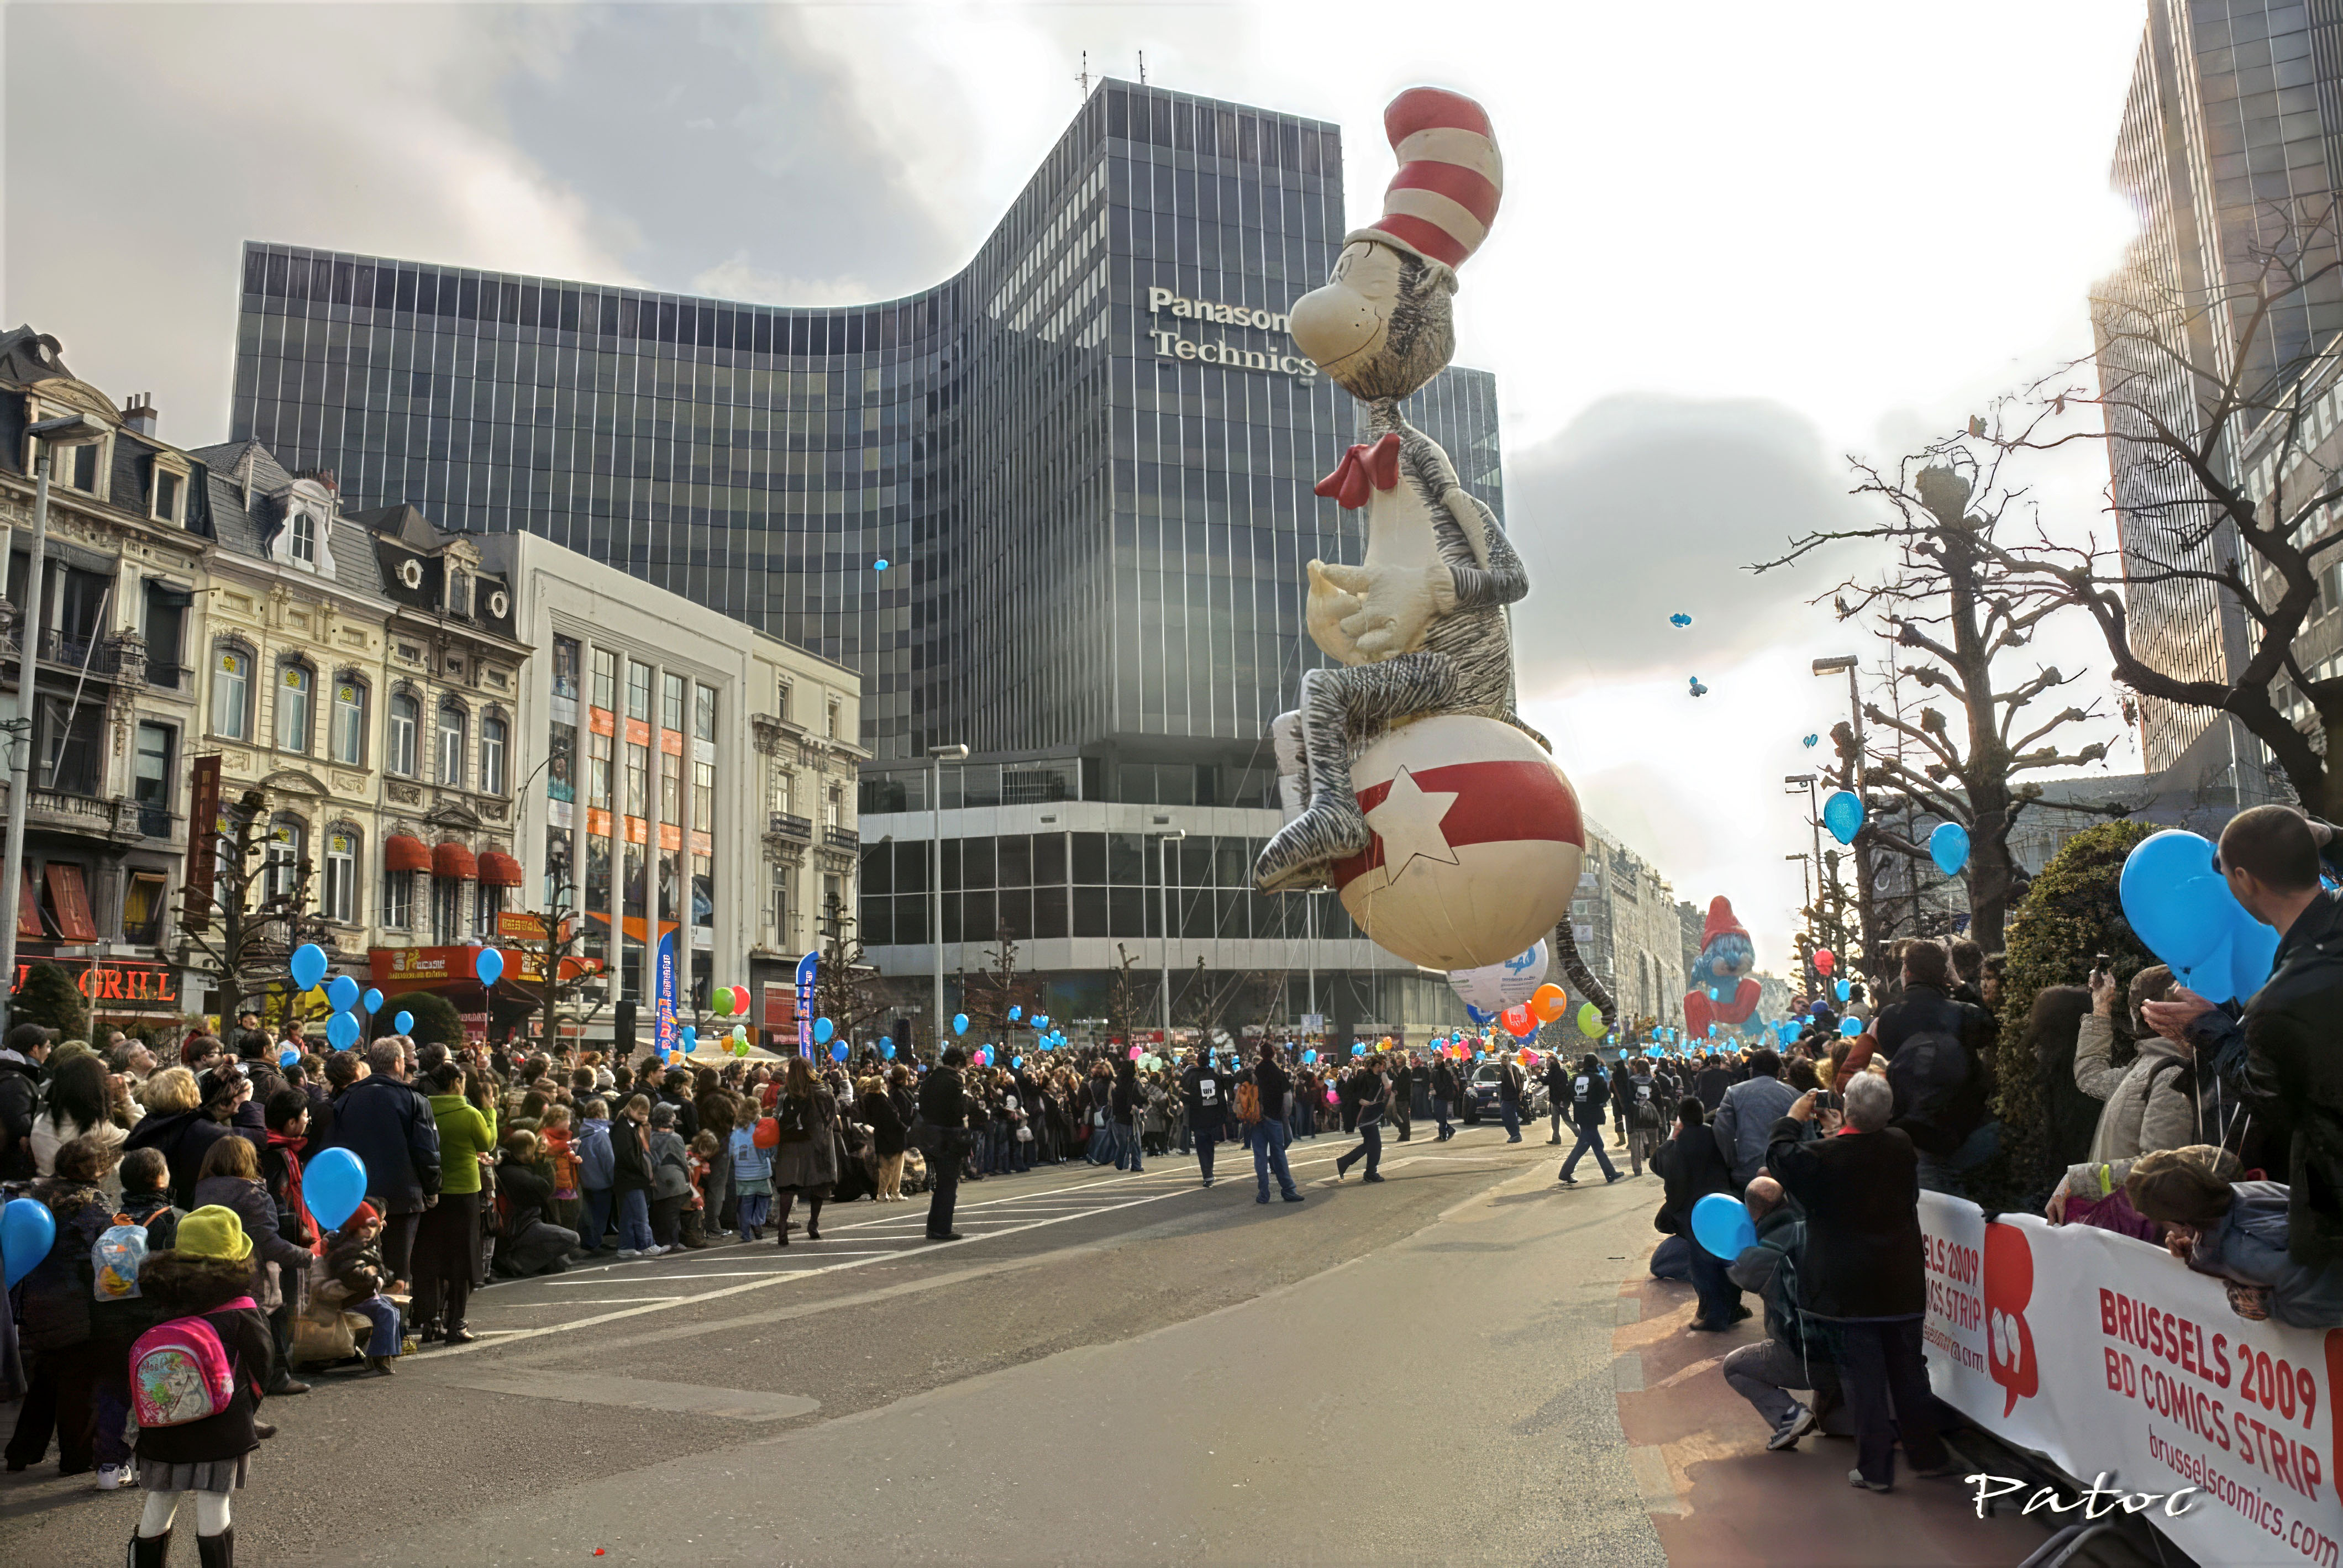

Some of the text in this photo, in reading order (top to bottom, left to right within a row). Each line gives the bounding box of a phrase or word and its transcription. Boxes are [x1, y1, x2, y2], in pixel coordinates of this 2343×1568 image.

[1149, 287, 1291, 333] Panason
[1149, 327, 1318, 377] Technics
[78, 969, 176, 1002] GRILL
[1945, 1287, 1981, 1332] STRIP
[2099, 1288, 2316, 1430] BRUSSELS 2009
[2104, 1346, 2321, 1502] BD COMICS STRIP
[2149, 1424, 2339, 1568] brusselscomics.com
